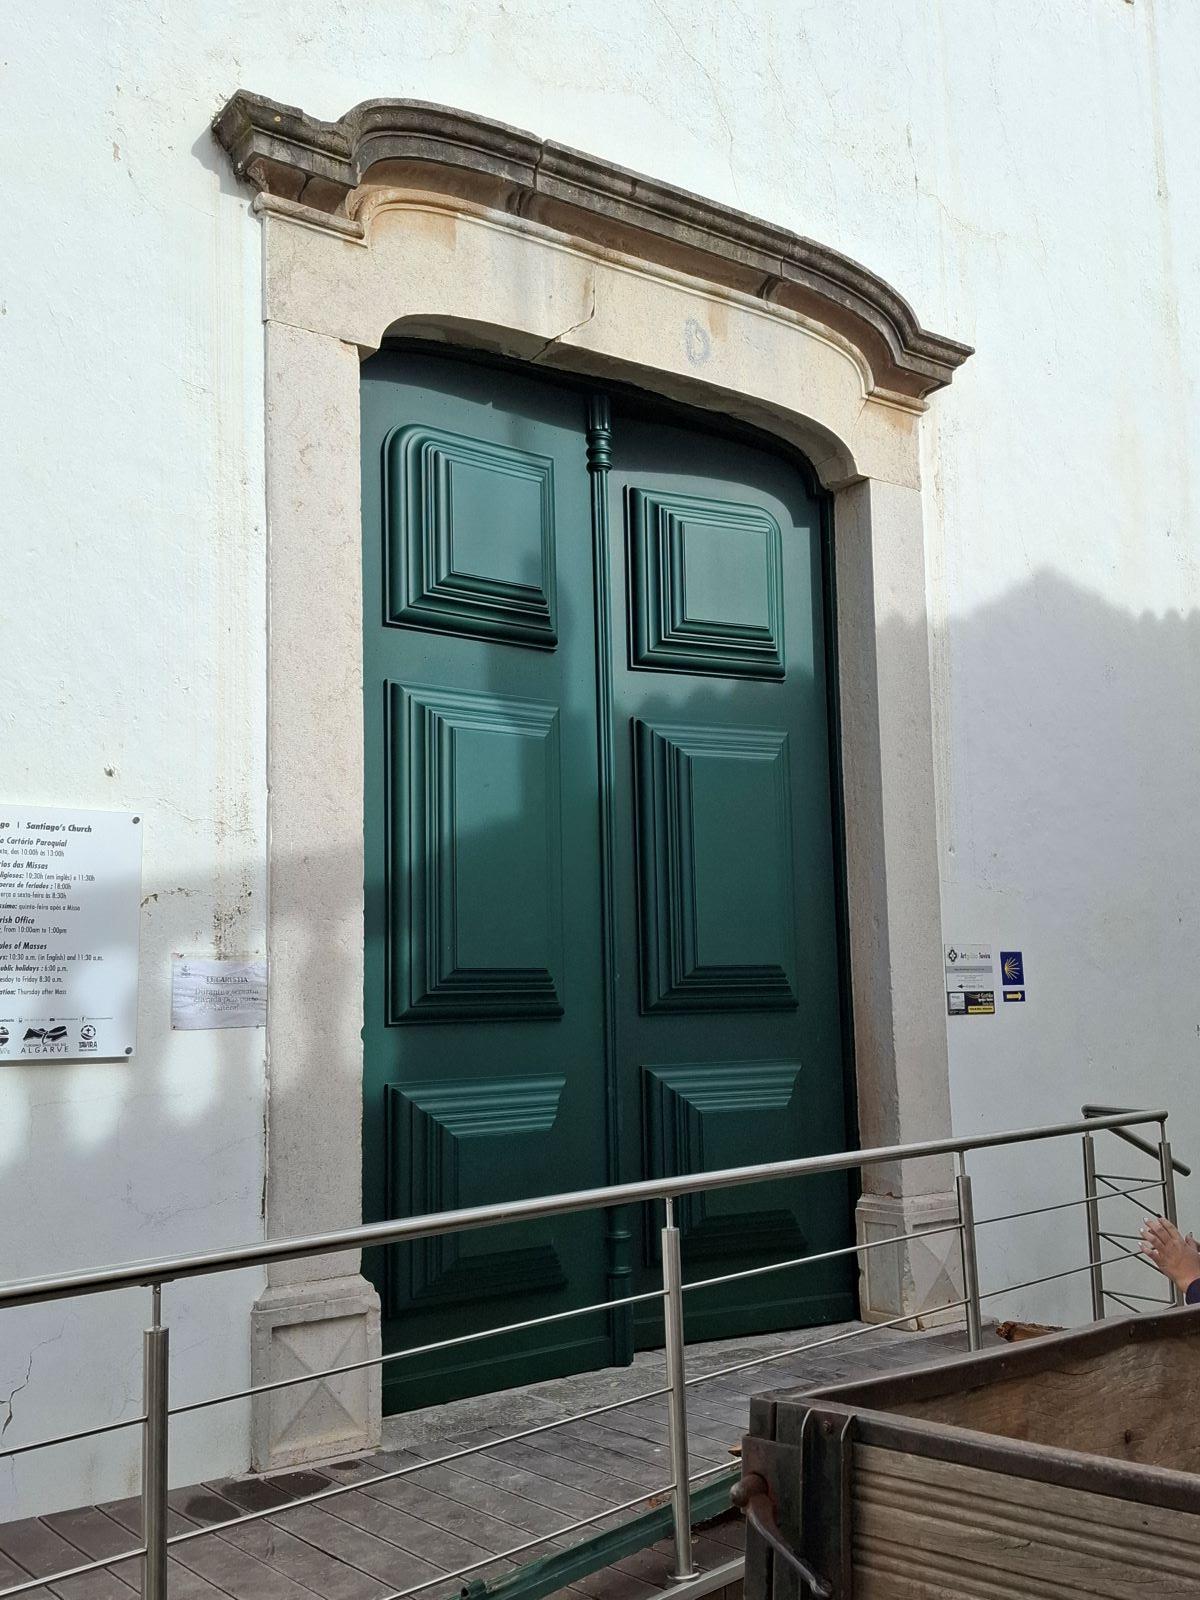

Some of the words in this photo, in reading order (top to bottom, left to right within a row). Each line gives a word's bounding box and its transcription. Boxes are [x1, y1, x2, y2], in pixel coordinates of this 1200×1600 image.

[68, 824, 92, 832] Church
[36, 838, 67, 848] Paroquial
[13, 860, 24, 868] das
[26, 861, 48, 869] Missas
[15, 915, 35, 924] Office
[4, 925, 16, 933] from
[14, 941, 21, 949] of
[23, 941, 47, 950] Masses
[15, 964, 40, 973] holidays
[20, 1046, 69, 1054] ALGARVE
